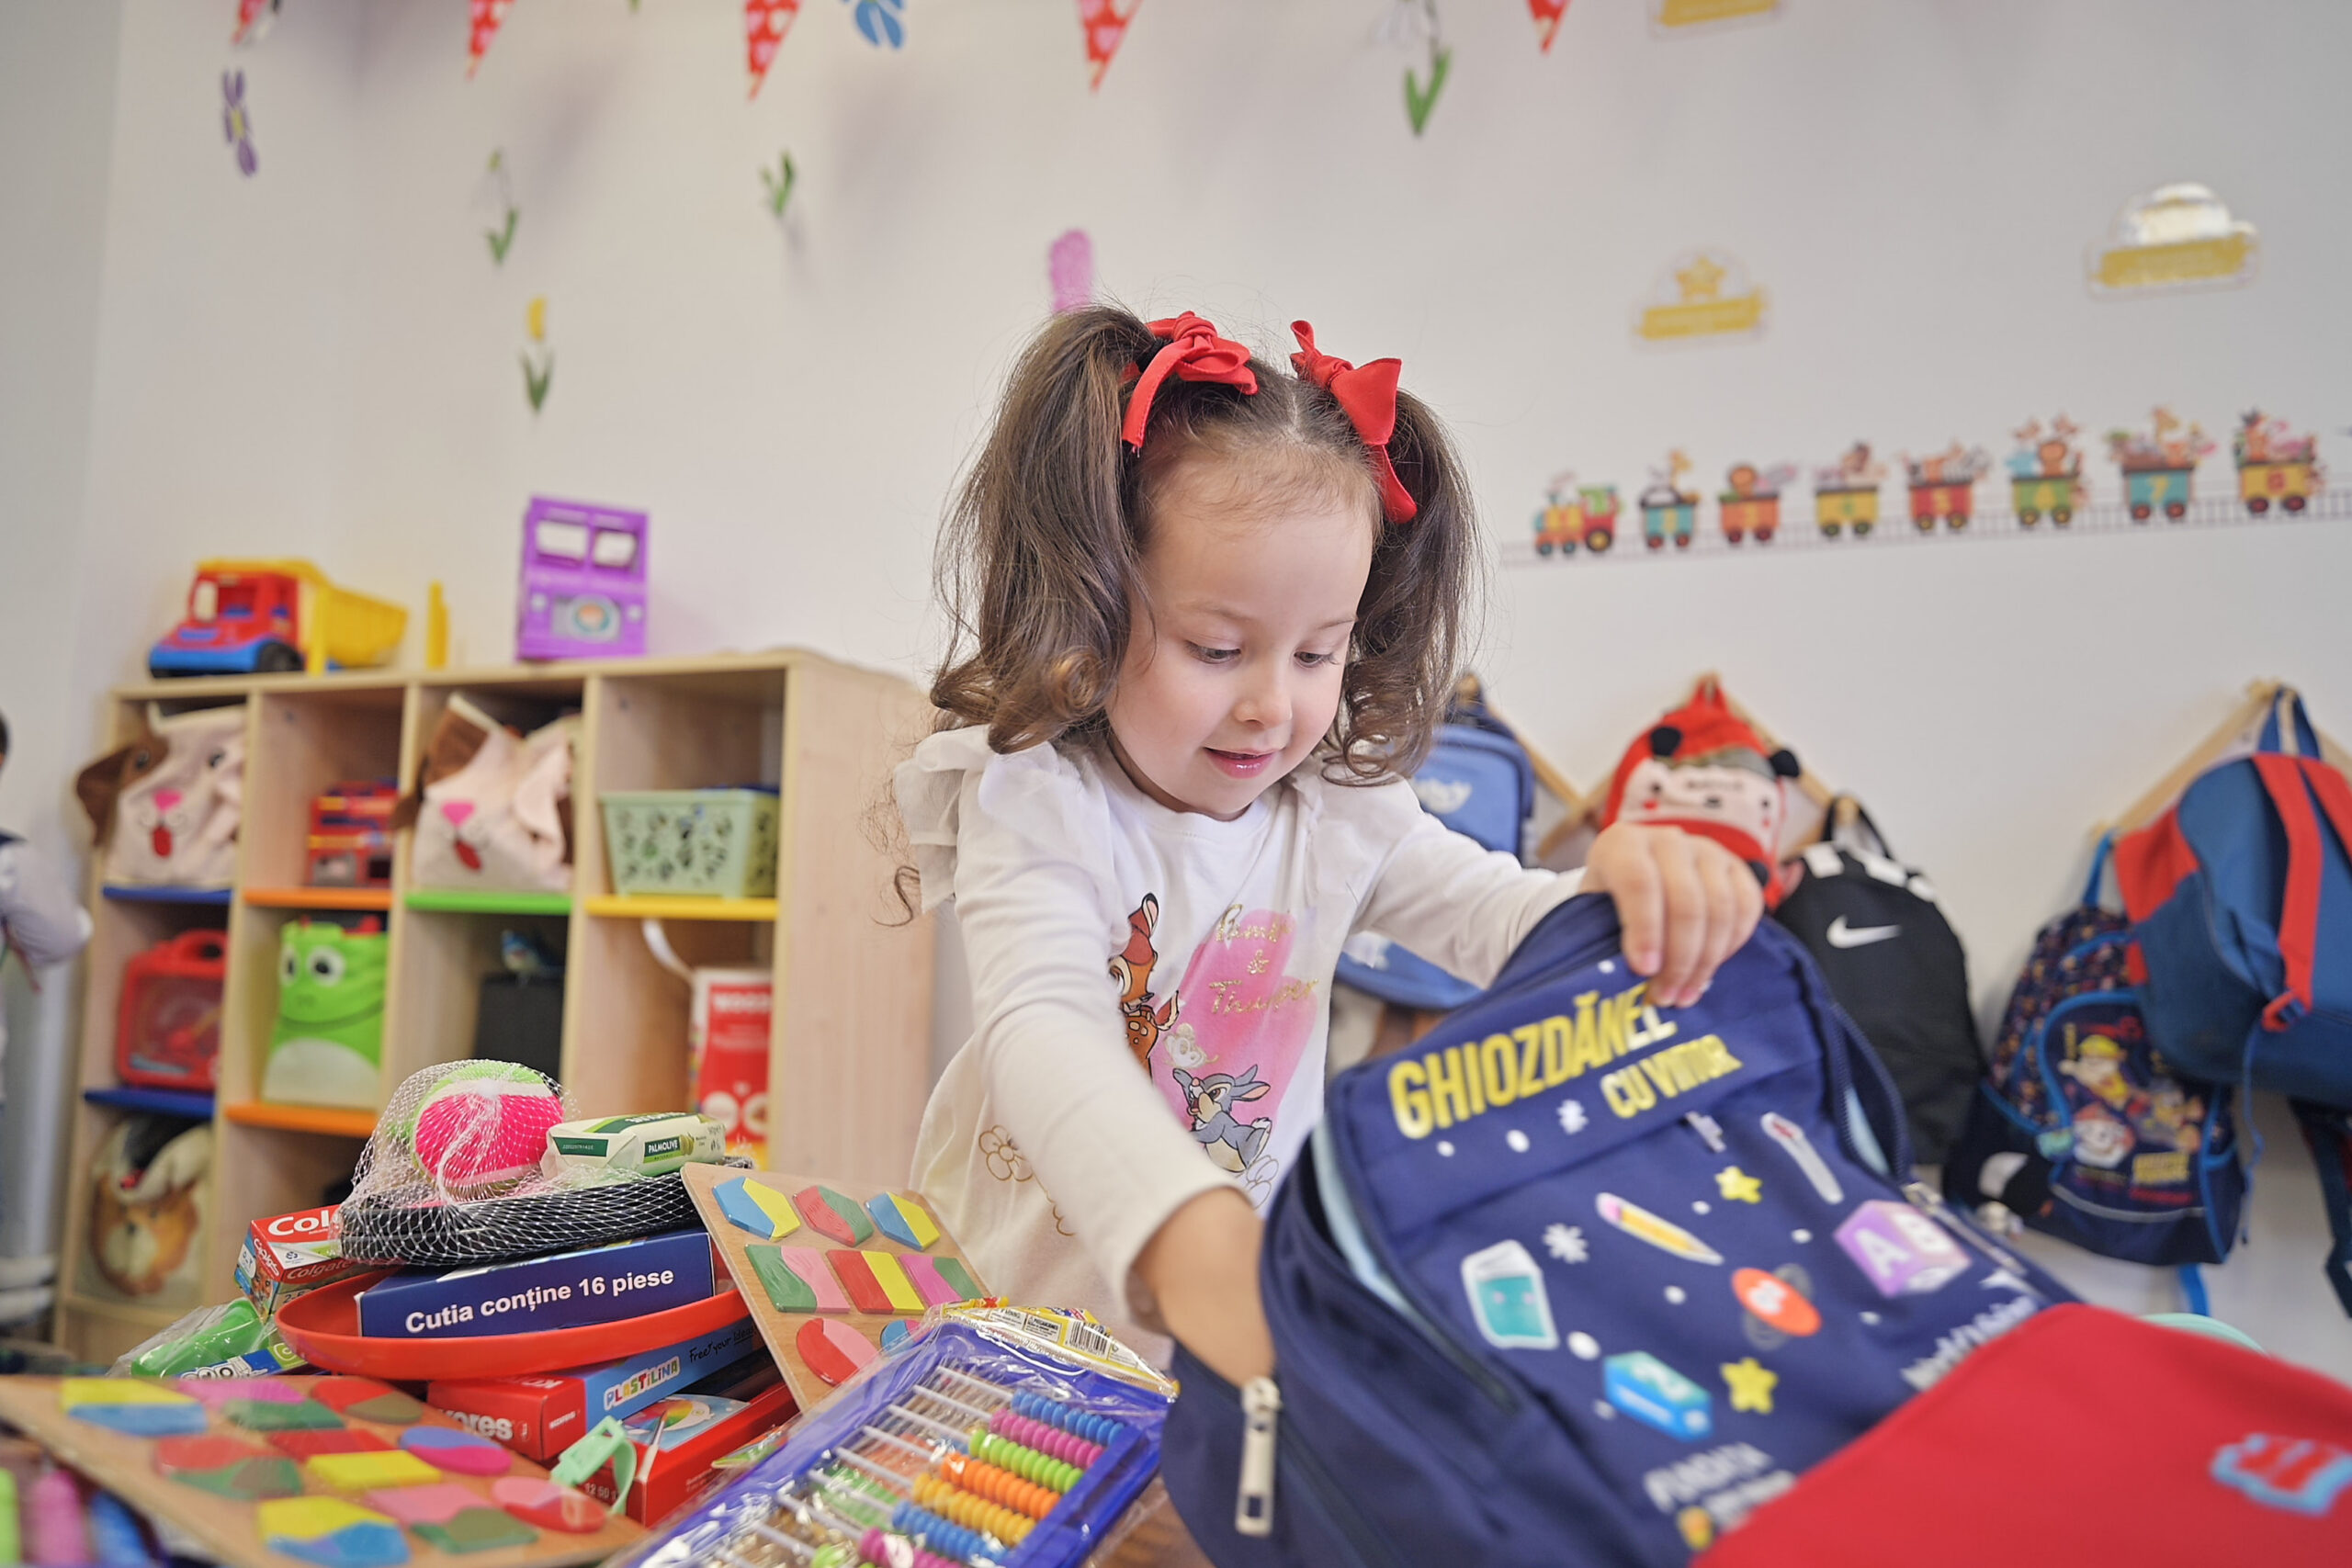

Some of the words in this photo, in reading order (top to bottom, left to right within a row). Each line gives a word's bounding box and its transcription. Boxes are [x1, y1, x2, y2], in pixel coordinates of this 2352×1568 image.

[1600, 1063, 1657, 1119] CU
[648, 1139, 679, 1154] PALMOLIVE
[1854, 1227, 1912, 1280] A
[405, 1303, 473, 1333] Cutia
[480, 1284, 572, 1313] conține
[578, 1276, 607, 1298] 16
[612, 1269, 675, 1298] piese
[713, 1337, 732, 1356] your
[443, 1409, 514, 1440] ores
